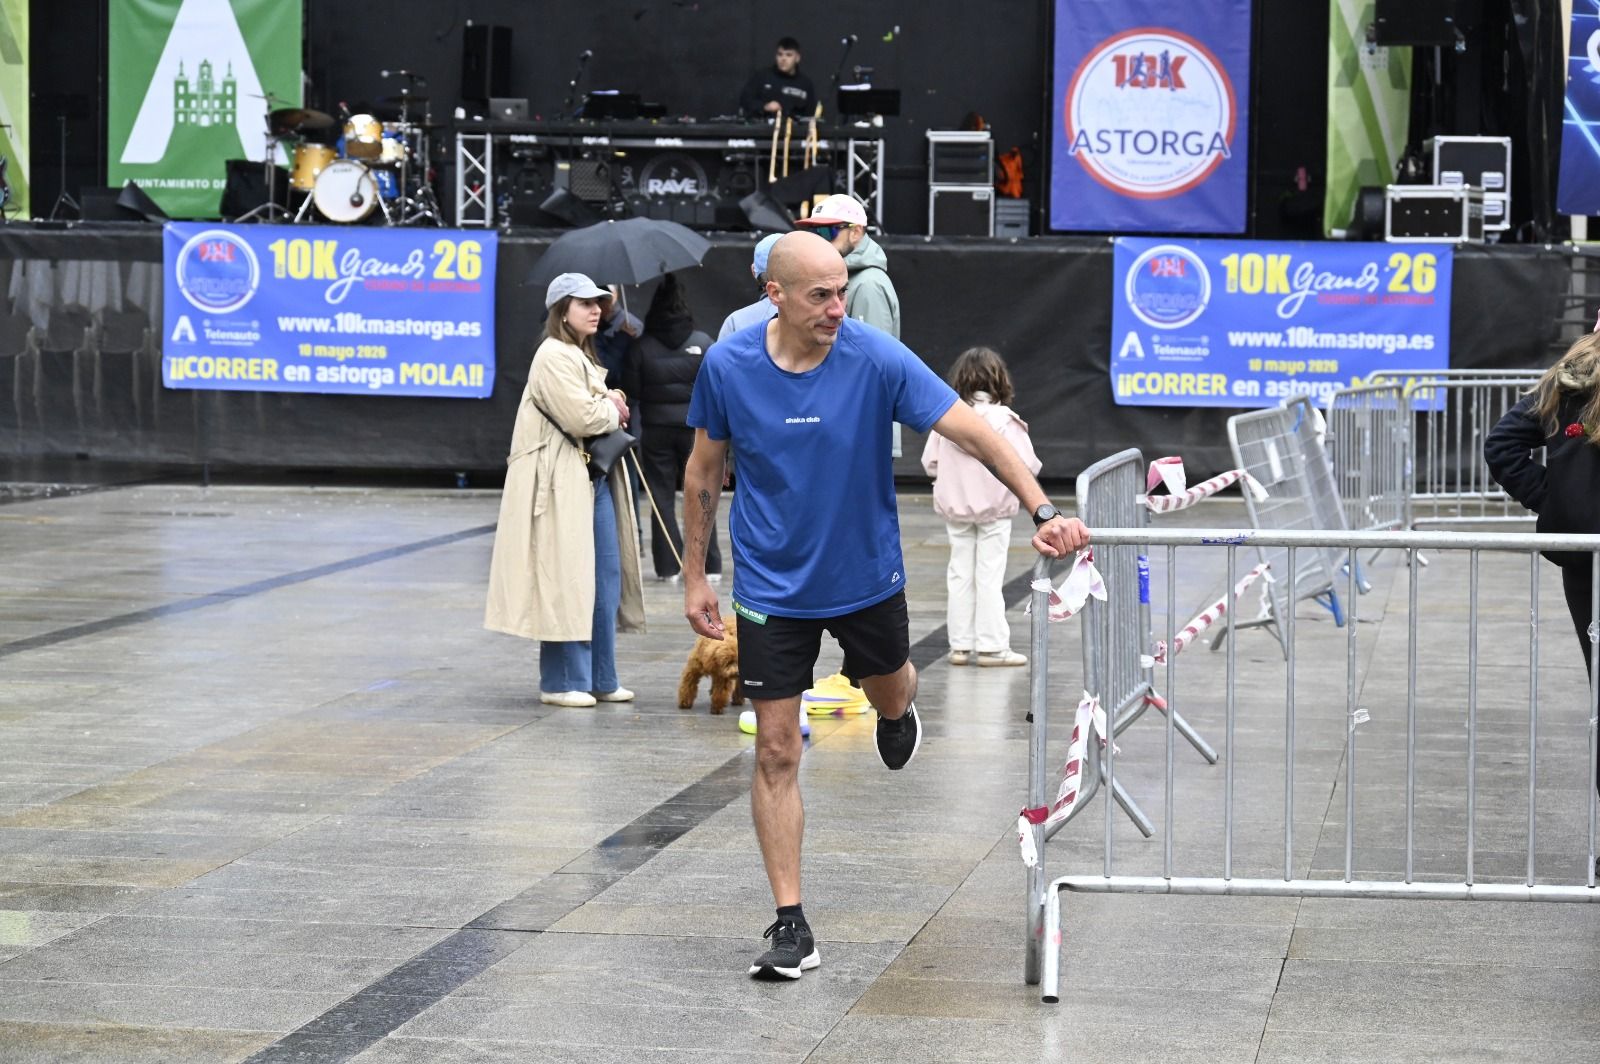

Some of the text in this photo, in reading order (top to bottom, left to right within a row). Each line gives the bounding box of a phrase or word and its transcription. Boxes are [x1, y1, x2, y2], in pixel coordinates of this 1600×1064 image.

[1070, 129, 1231, 157] ASTORGA
[122, 178, 210, 189] AUNTAMIENTO
[648, 177, 698, 195] RAVE
[268, 238, 339, 281] 10K
[1221, 253, 1292, 294] 10K
[204, 329, 261, 341] Telenauto
[277, 312, 482, 340] www.10kmastorga.es
[1227, 326, 1435, 354] www.10kmastorga.es
[314, 346, 354, 361] mayo
[1153, 344, 1209, 356] Telenauto
[169, 356, 484, 389] ¡¡CORRER en astorga MOLA!!
[1264, 360, 1305, 376] mayo
[1118, 372, 1227, 397] ¡¡CORRER
[1232, 379, 1260, 397] en
[1265, 379, 1346, 402] astorga
